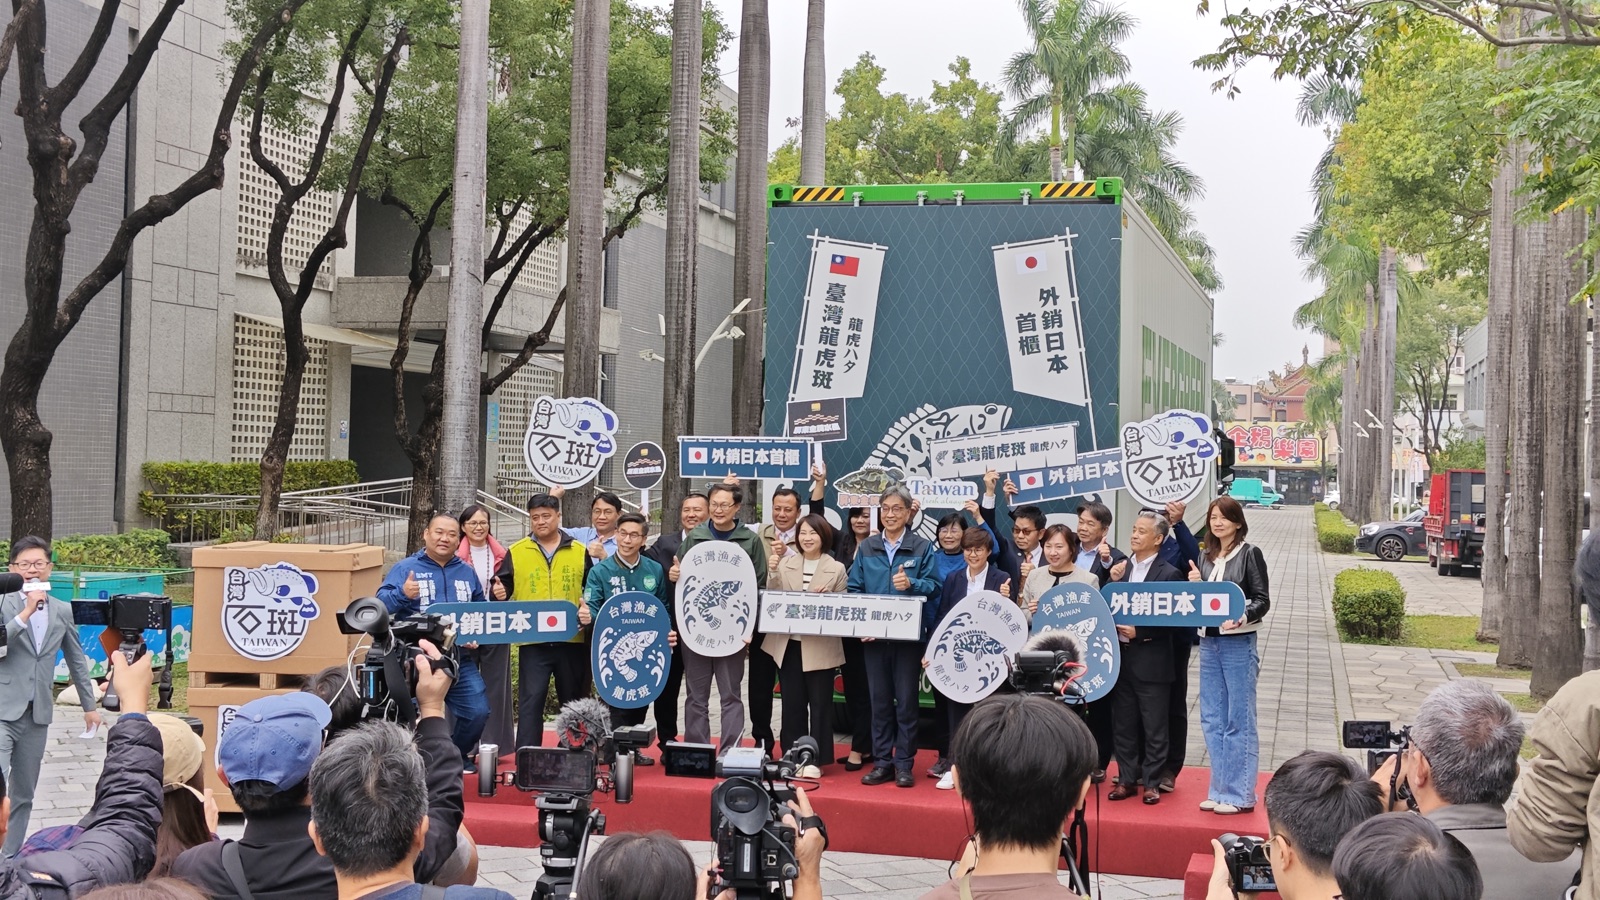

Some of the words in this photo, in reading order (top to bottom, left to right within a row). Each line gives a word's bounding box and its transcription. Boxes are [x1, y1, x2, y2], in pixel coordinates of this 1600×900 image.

[812, 282, 847, 390] 臺灣龍虎斑
[1016, 312, 1041, 356] 首櫃
[1039, 286, 1069, 374] 外銷日本
[843, 317, 864, 374] 龍虎ハタ
[711, 447, 800, 466] 外銷日本首櫃
[952, 441, 1026, 464] 臺灣龍虎斑
[540, 462, 582, 477] TAIWAN
[910, 479, 975, 497] Taiwan
[1146, 482, 1192, 497] TAIWAN
[692, 550, 742, 567] 台灣漁產
[608, 600, 659, 618] 台灣漁產
[785, 603, 867, 622] 臺灣龍虎斑
[870, 610, 913, 622] 龍虎ハタ
[1042, 591, 1092, 616] 台灣漁產
[1056, 607, 1081, 619] TAIWAN
[1110, 591, 1196, 616] 外銷日本
[977, 597, 1022, 635] 台灣漁產
[241, 637, 288, 647] TAIWAN
[612, 684, 651, 701] 龍虎斑
